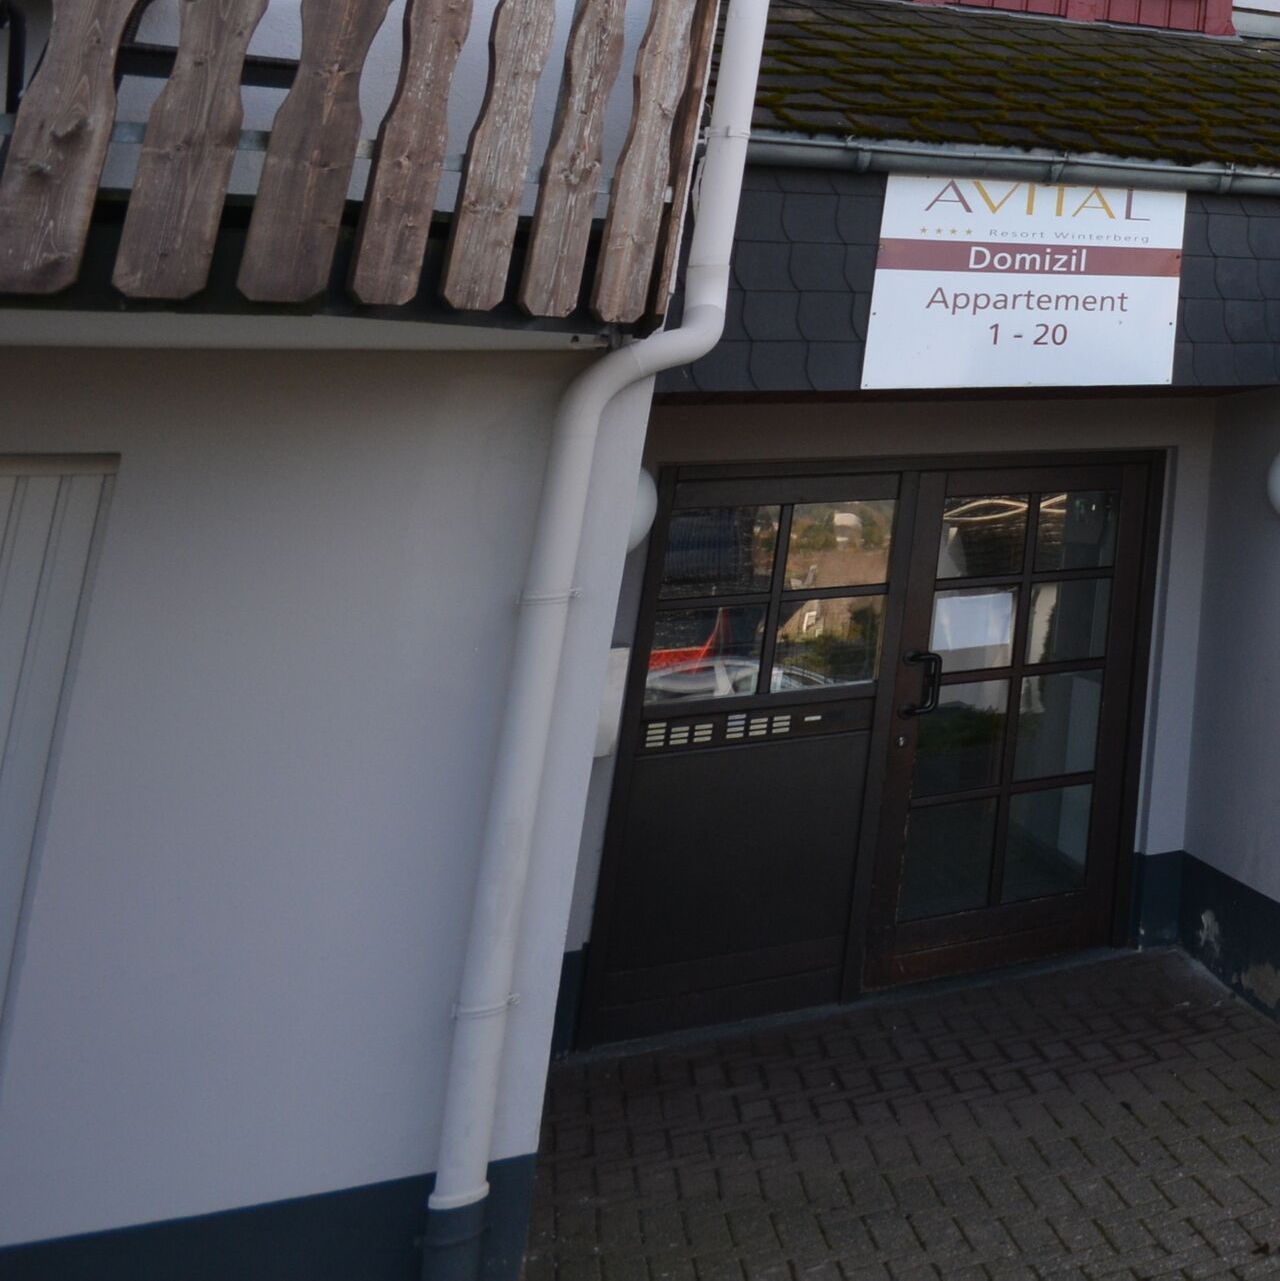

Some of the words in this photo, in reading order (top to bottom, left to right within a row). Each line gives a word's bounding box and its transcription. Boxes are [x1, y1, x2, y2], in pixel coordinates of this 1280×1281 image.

[924, 178, 1151, 222] AVITAL
[988, 228, 1045, 239] Resort
[1054, 231, 1150, 244] Winterberg
[967, 246, 1088, 273] Domizil
[925, 286, 1129, 316] Appartement
[988, 323, 1000, 346] 1
[1032, 323, 1069, 347] 20
